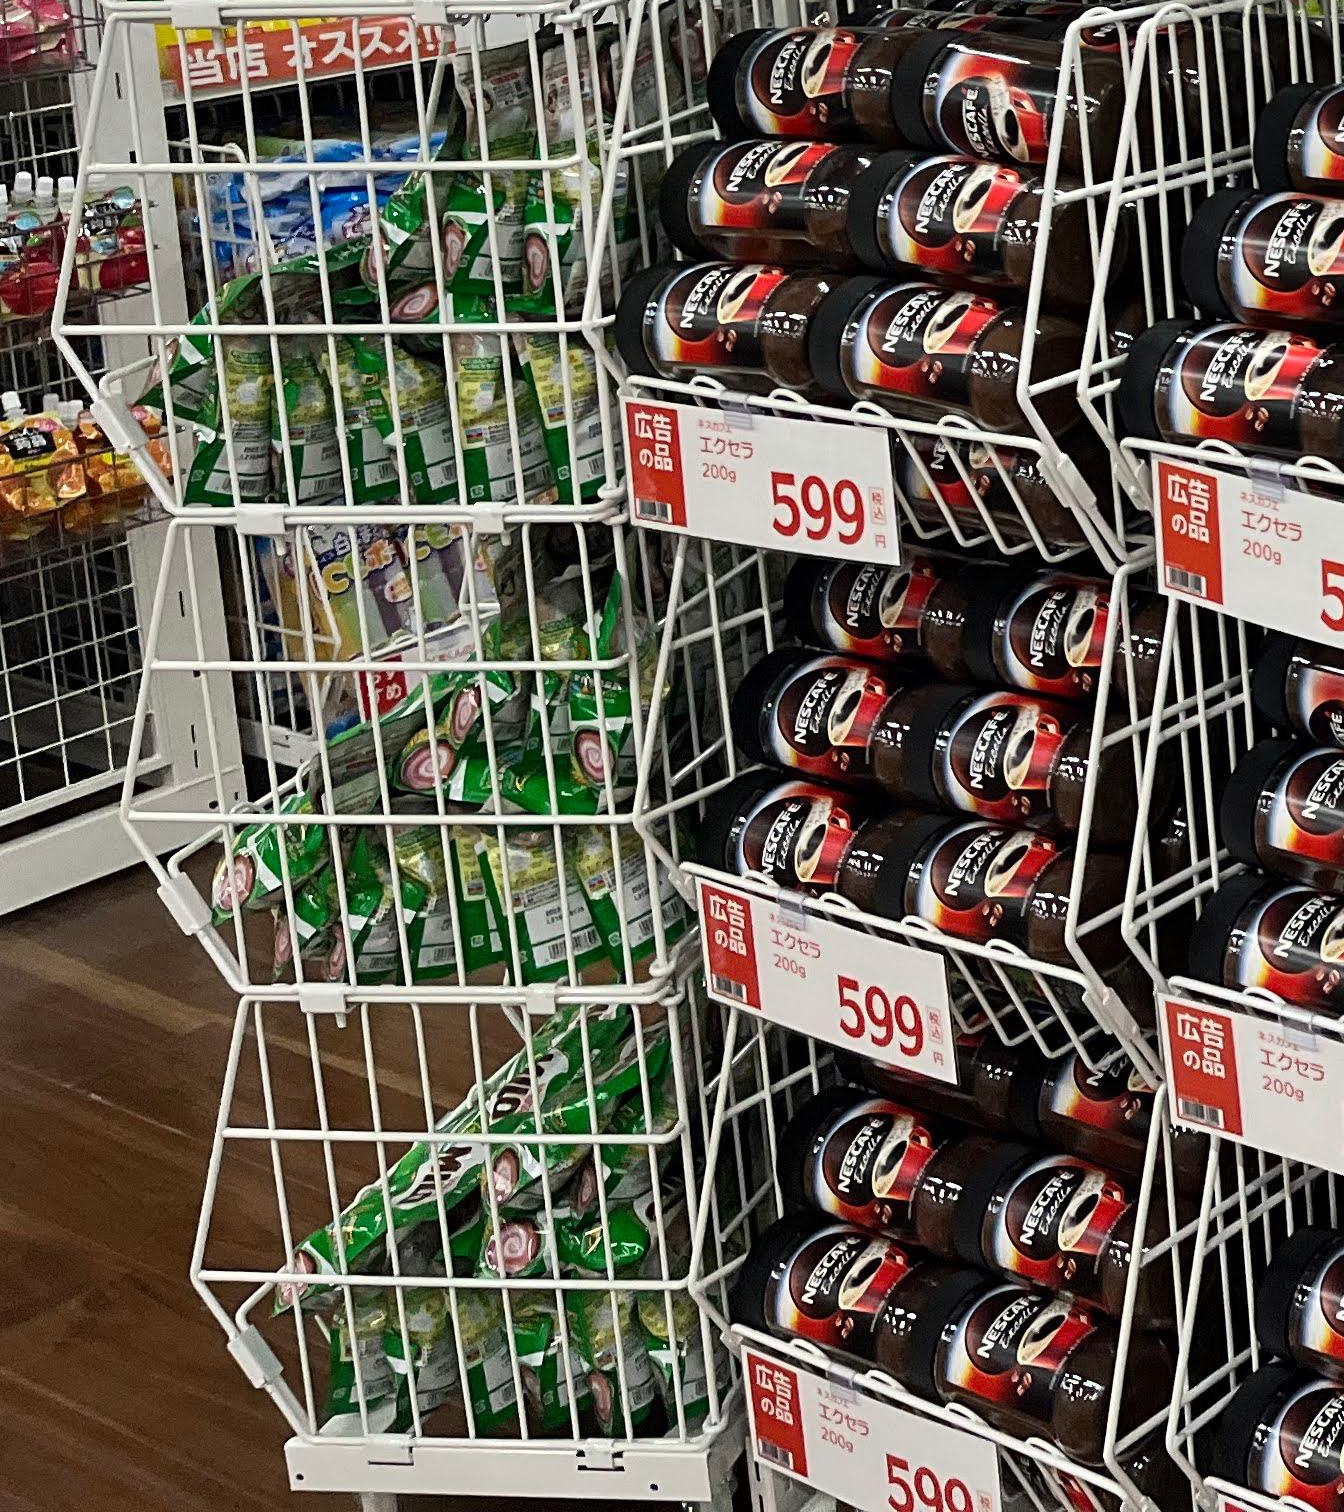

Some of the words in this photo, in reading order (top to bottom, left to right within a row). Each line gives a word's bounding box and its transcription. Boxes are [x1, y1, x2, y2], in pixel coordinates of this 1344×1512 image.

[633, 410, 673, 444] 広告
[637, 444, 674, 473] の品
[699, 434, 754, 459] エクセラ
[701, 461, 738, 486] 200g
[769, 470, 866, 545] 599
[1167, 472, 1211, 510] 広告
[1171, 509, 1210, 545] の品
[1241, 509, 1303, 543] エクセラ
[1242, 538, 1283, 567] 200g
[709, 894, 746, 928] 広告
[714, 928, 748, 958] の品
[770, 927, 822, 959] エクセラ
[772, 953, 808, 979] 200g
[836, 974, 925, 1057] 599
[1176, 1011, 1226, 1049] 広告
[1182, 1047, 1227, 1080] の品
[1260, 1047, 1326, 1082] エクセラ
[1262, 1075, 1306, 1103] 200g
[754, 1362, 793, 1396] 広告
[760, 1394, 794, 1426] の品
[816, 1402, 871, 1437] エクセラ
[820, 1426, 855, 1453] 200g
